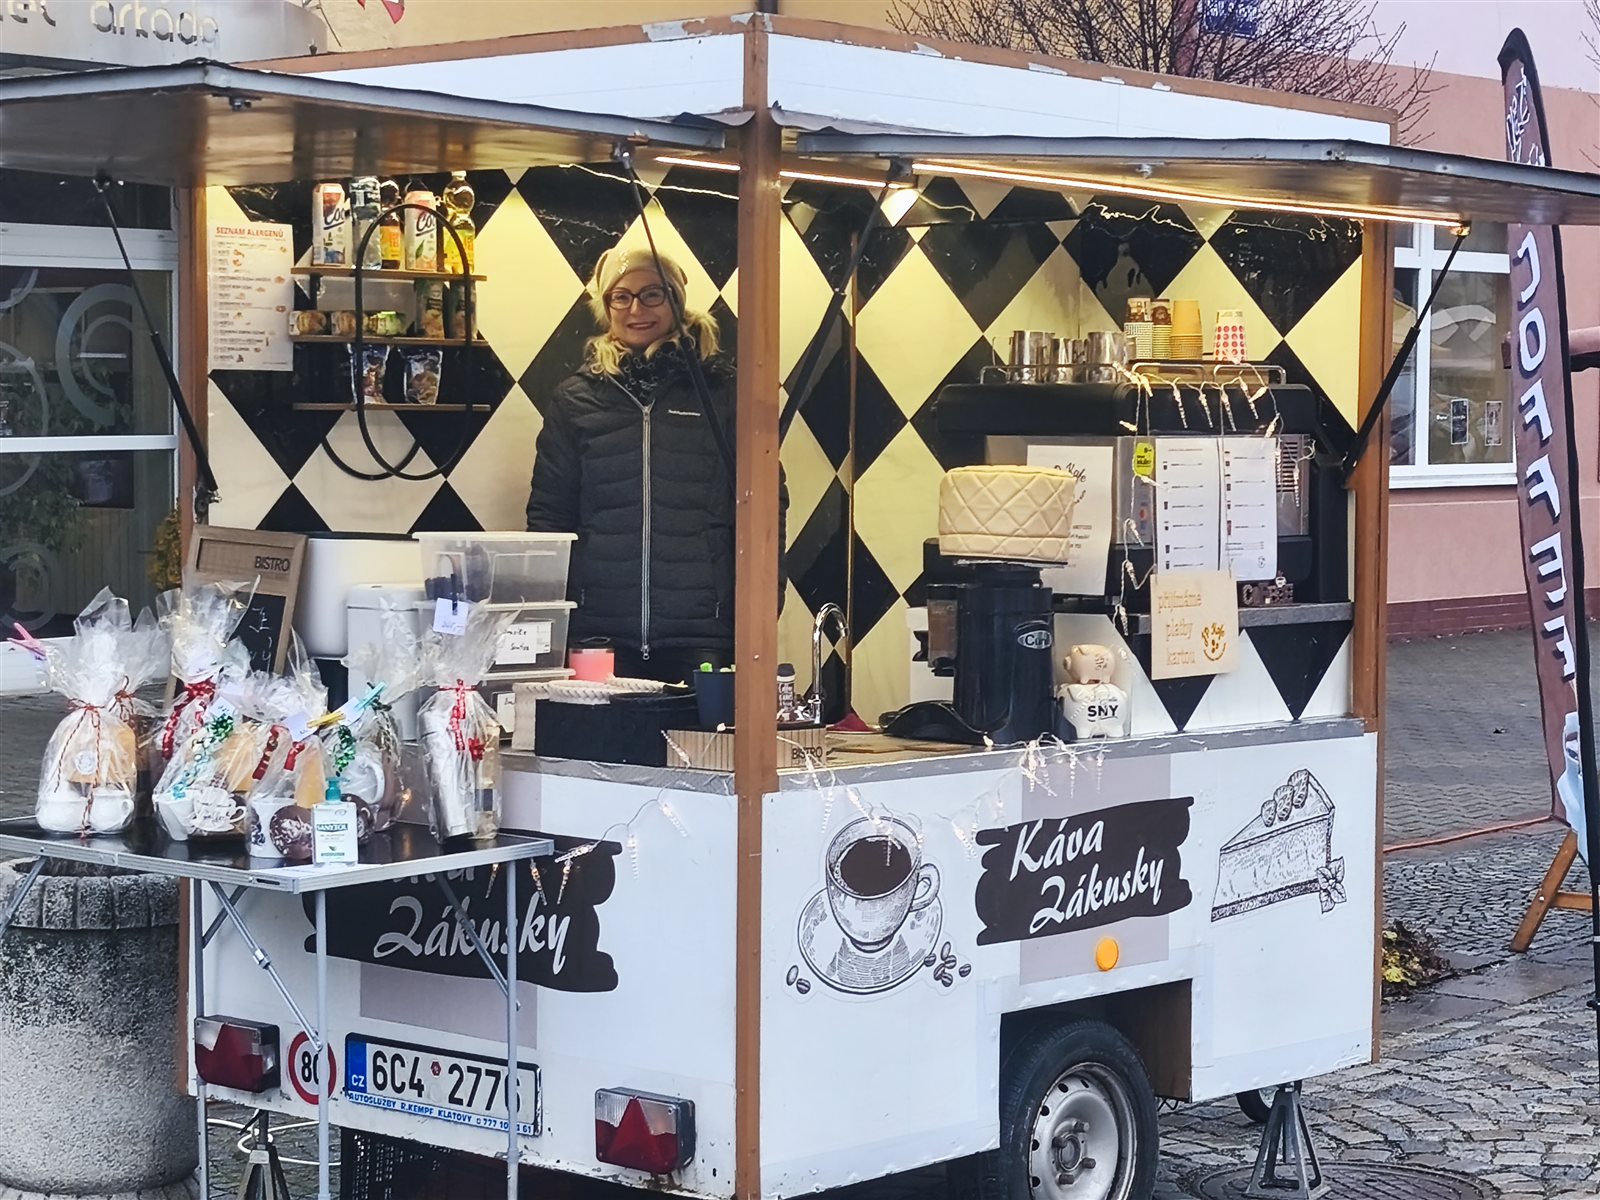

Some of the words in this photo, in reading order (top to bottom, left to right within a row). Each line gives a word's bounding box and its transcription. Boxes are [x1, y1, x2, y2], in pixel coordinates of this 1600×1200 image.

[254, 555, 291, 572] BISTRO
[1087, 704, 1119, 717] SNY
[1009, 817, 1105, 882] Káva
[1029, 845, 1164, 934] Zákusky
[351, 1073, 365, 1088] CZ
[372, 1050, 425, 1098] 6C4
[438, 1109, 473, 1123] KLATOVY
